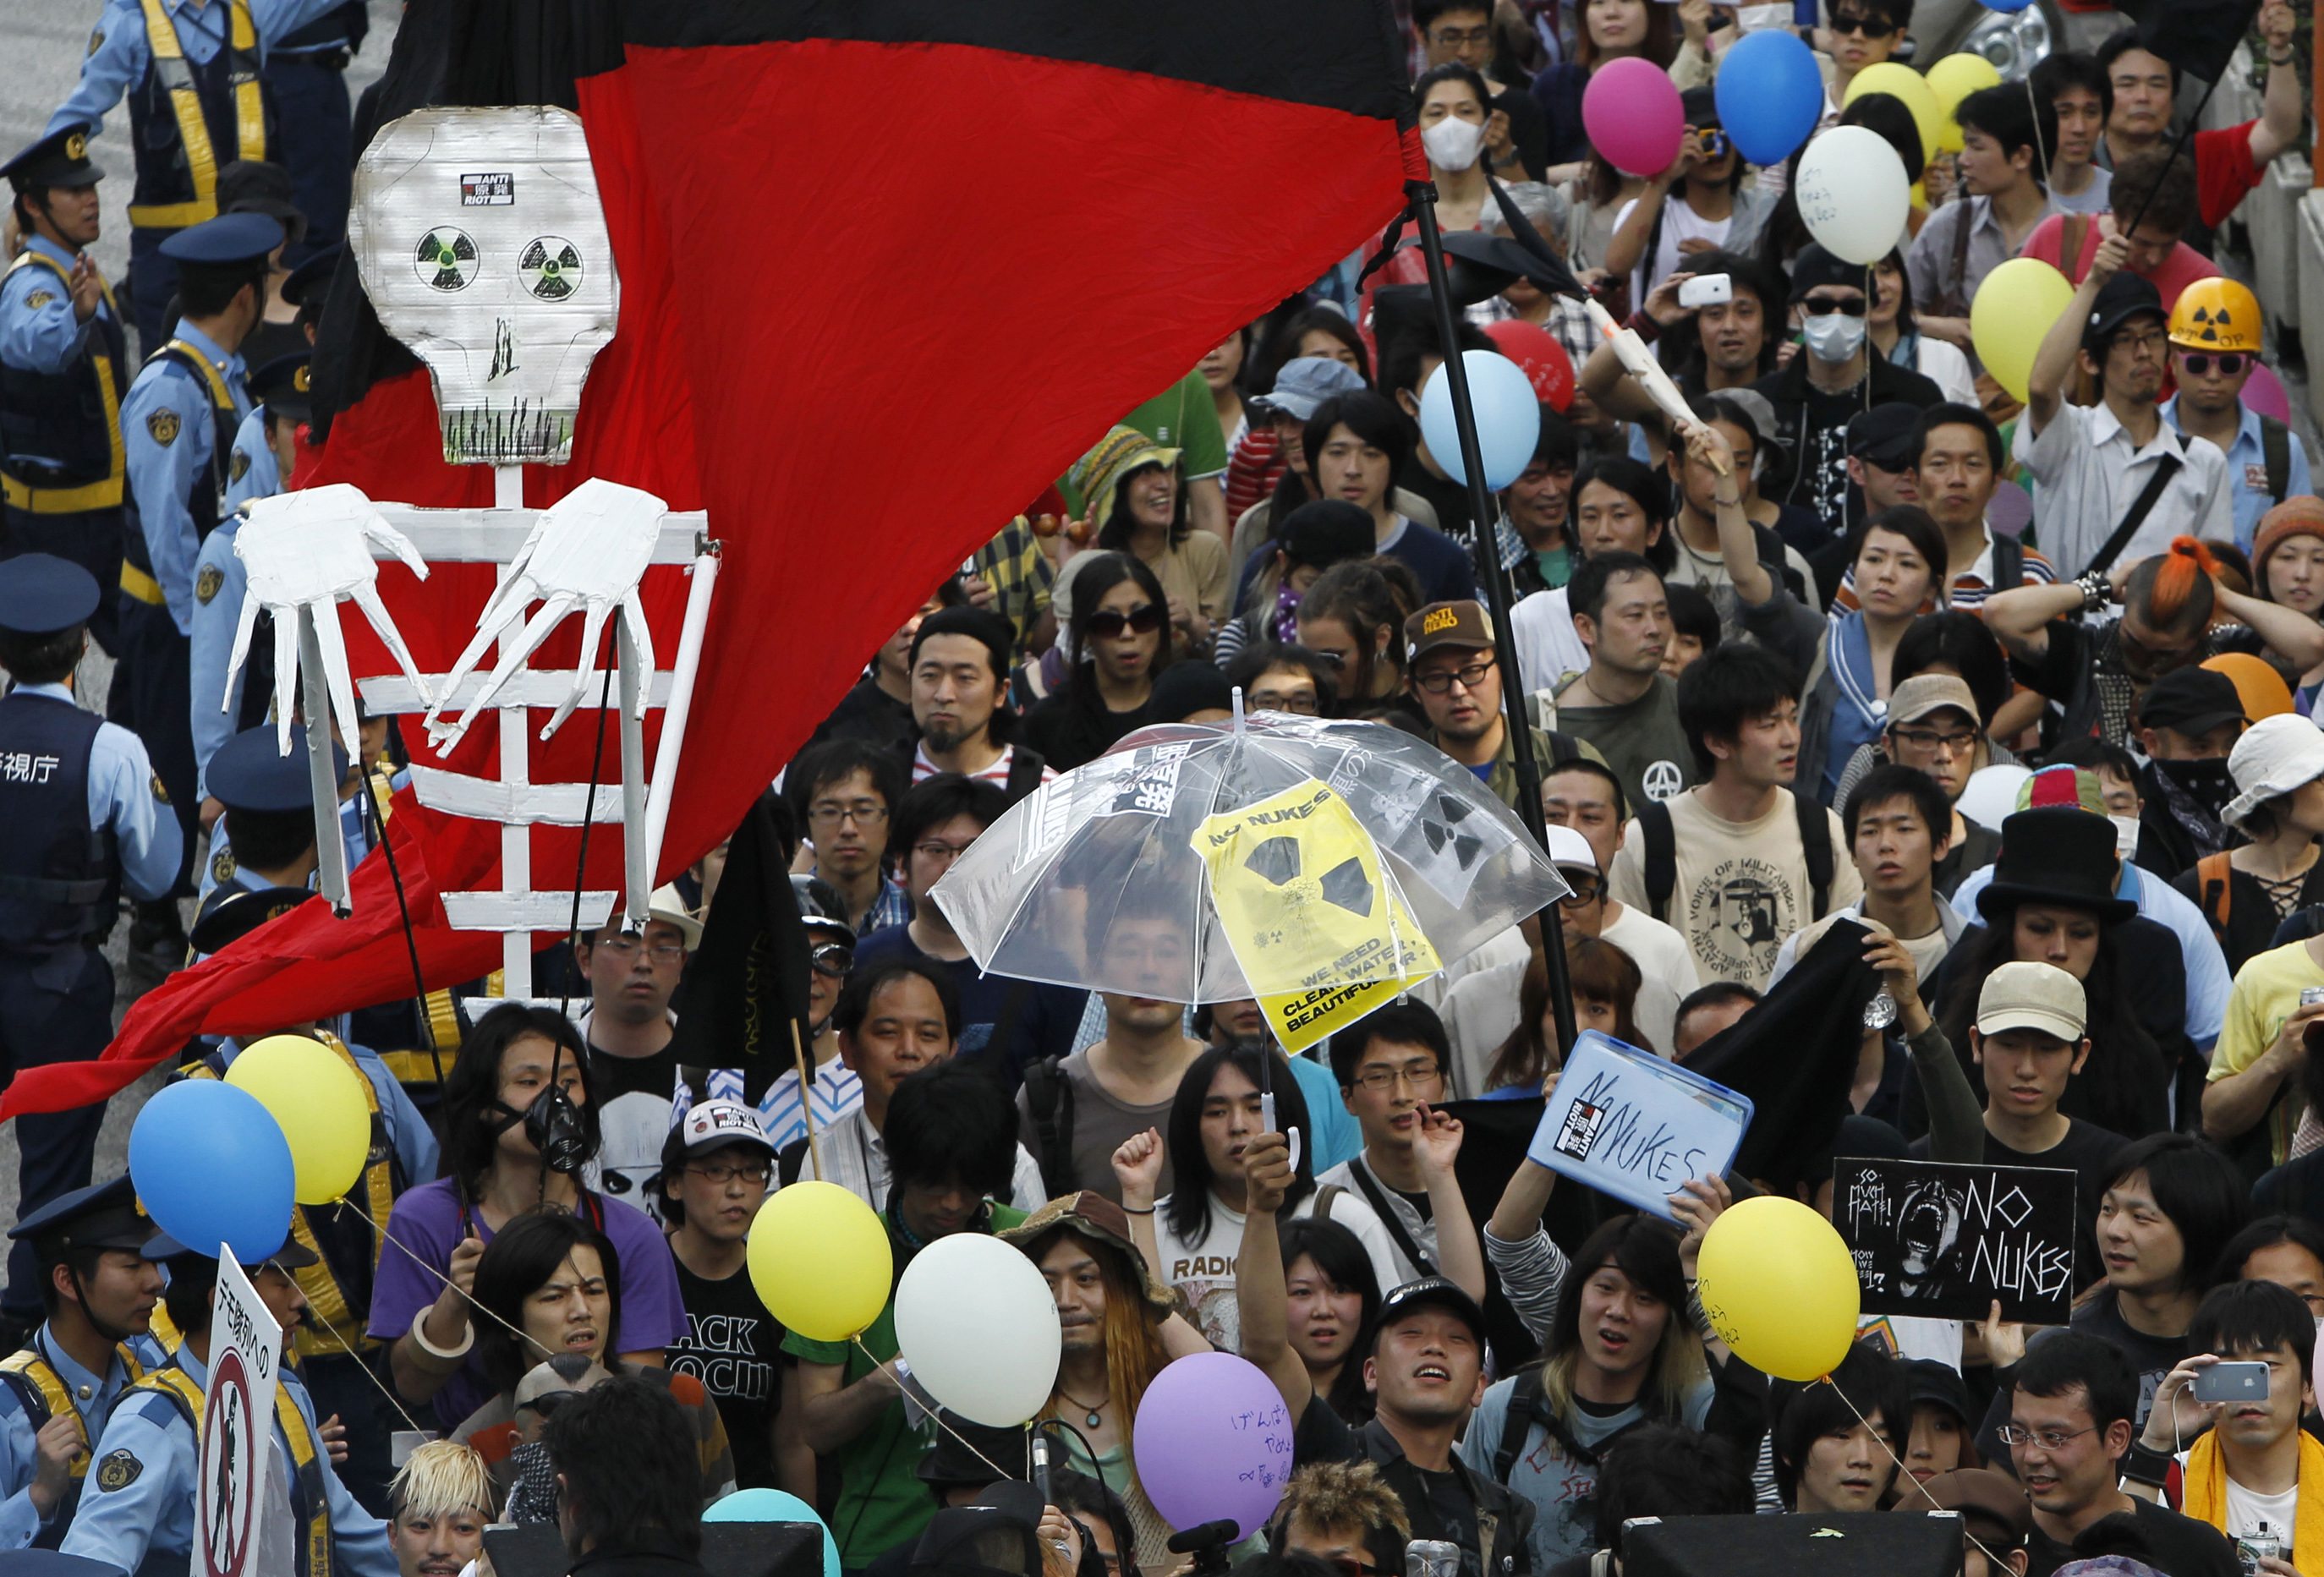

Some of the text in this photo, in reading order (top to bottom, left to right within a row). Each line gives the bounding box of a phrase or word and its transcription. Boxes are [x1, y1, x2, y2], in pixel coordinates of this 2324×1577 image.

[481, 174, 509, 184] ANTI
[464, 194, 491, 205] RIOT
[1424, 616, 1458, 635] HERO
[1425, 607, 1453, 621] ANTI
[0, 752, 60, 784] 視庁
[1247, 789, 1331, 826] NUKES
[1690, 875, 1713, 921] VOICE
[1714, 860, 1733, 876] OF
[1301, 938, 1380, 987] WE NEED
[1734, 970, 1752, 981] OF
[1283, 977, 1340, 1017] CLEAN
[1285, 974, 1381, 1032] BEAUTIFUL
[1566, 1100, 1584, 1130] RIOT
[1576, 1126, 1595, 1157] ANTI
[1964, 1172, 2033, 1229] NO
[1969, 1231, 2070, 1301] NUKES
[218, 1277, 270, 1380] デモ隊列への
